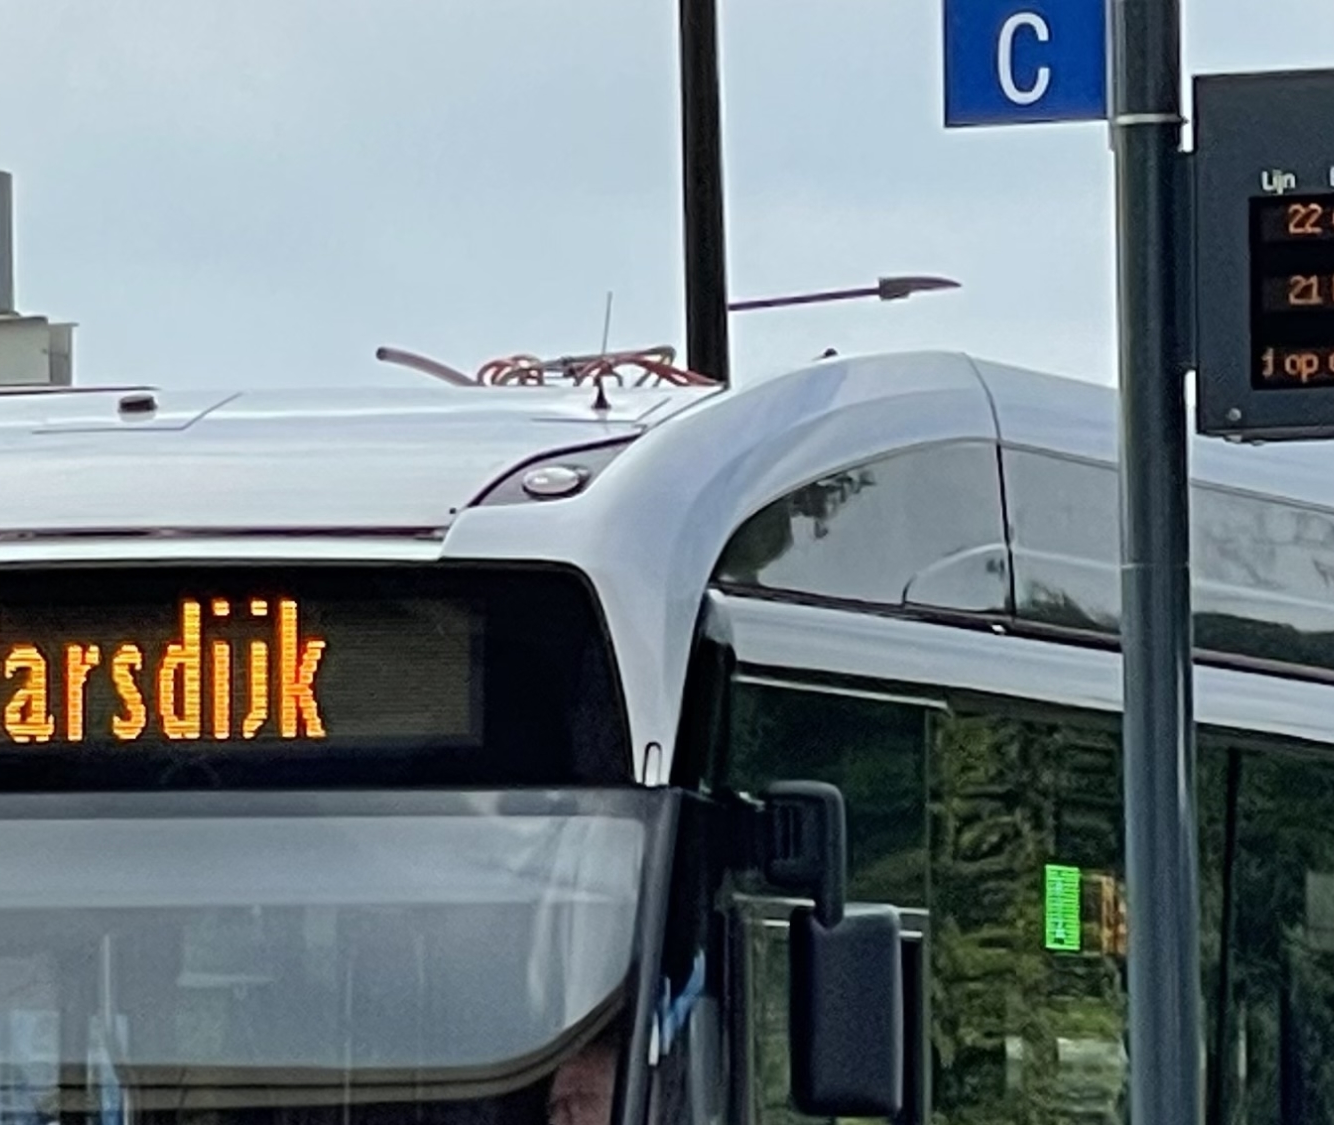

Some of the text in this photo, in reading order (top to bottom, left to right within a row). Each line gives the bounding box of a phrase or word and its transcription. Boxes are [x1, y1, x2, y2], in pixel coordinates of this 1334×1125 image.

[998, 12, 1050, 105] C
[1261, 169, 1295, 194] Lijn
[1288, 202, 1323, 234] 22
[1288, 274, 1323, 305] 21
[1285, 353, 1319, 383] op
